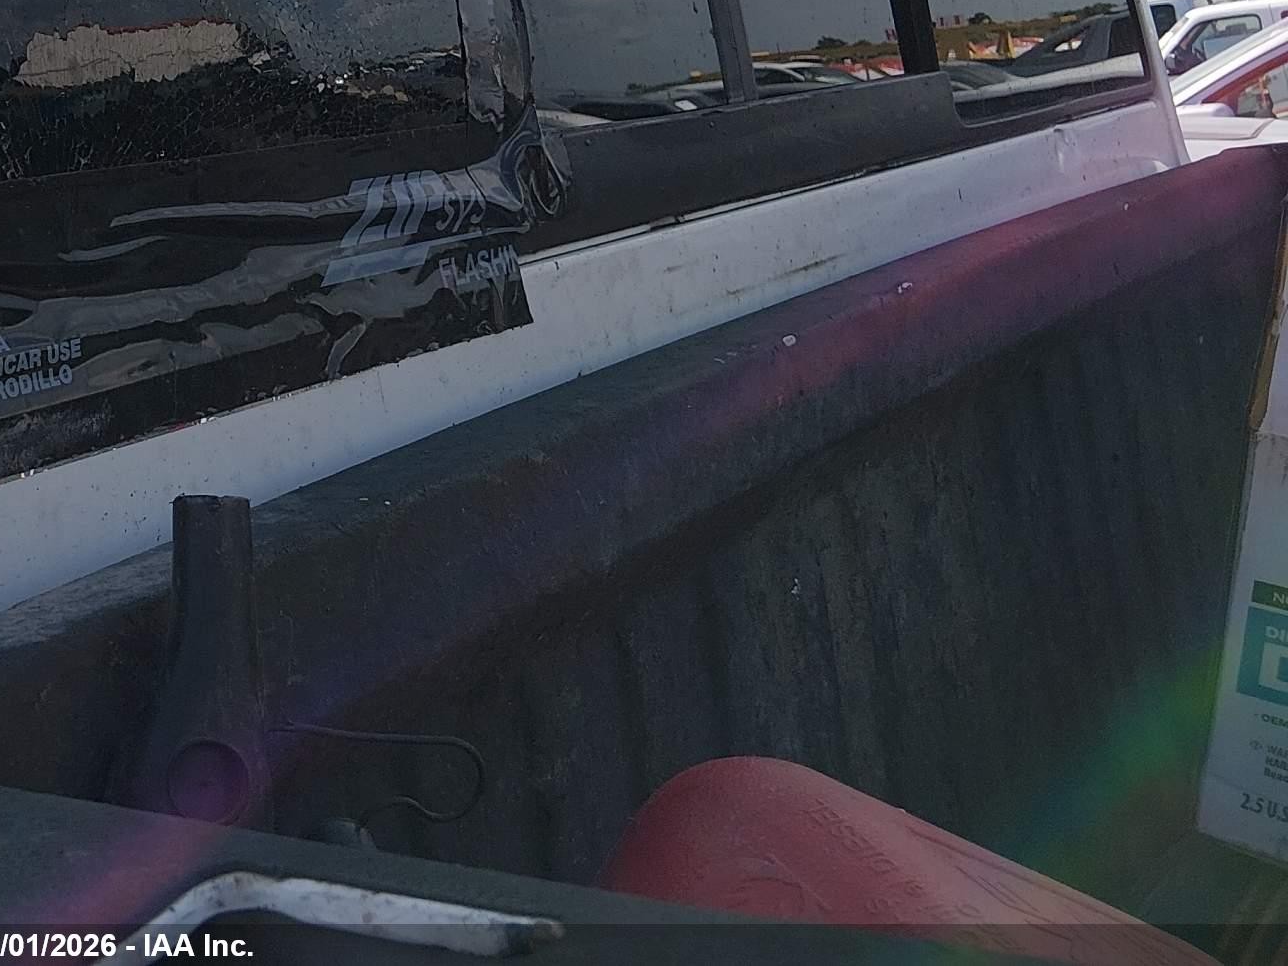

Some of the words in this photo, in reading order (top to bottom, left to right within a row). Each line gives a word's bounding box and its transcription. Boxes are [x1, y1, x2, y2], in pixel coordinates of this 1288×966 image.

[46, 337, 82, 364] USE
[1273, 592, 1288, 604] N
[1265, 626, 1288, 642] DI
[1240, 792, 1264, 813] 2.5
